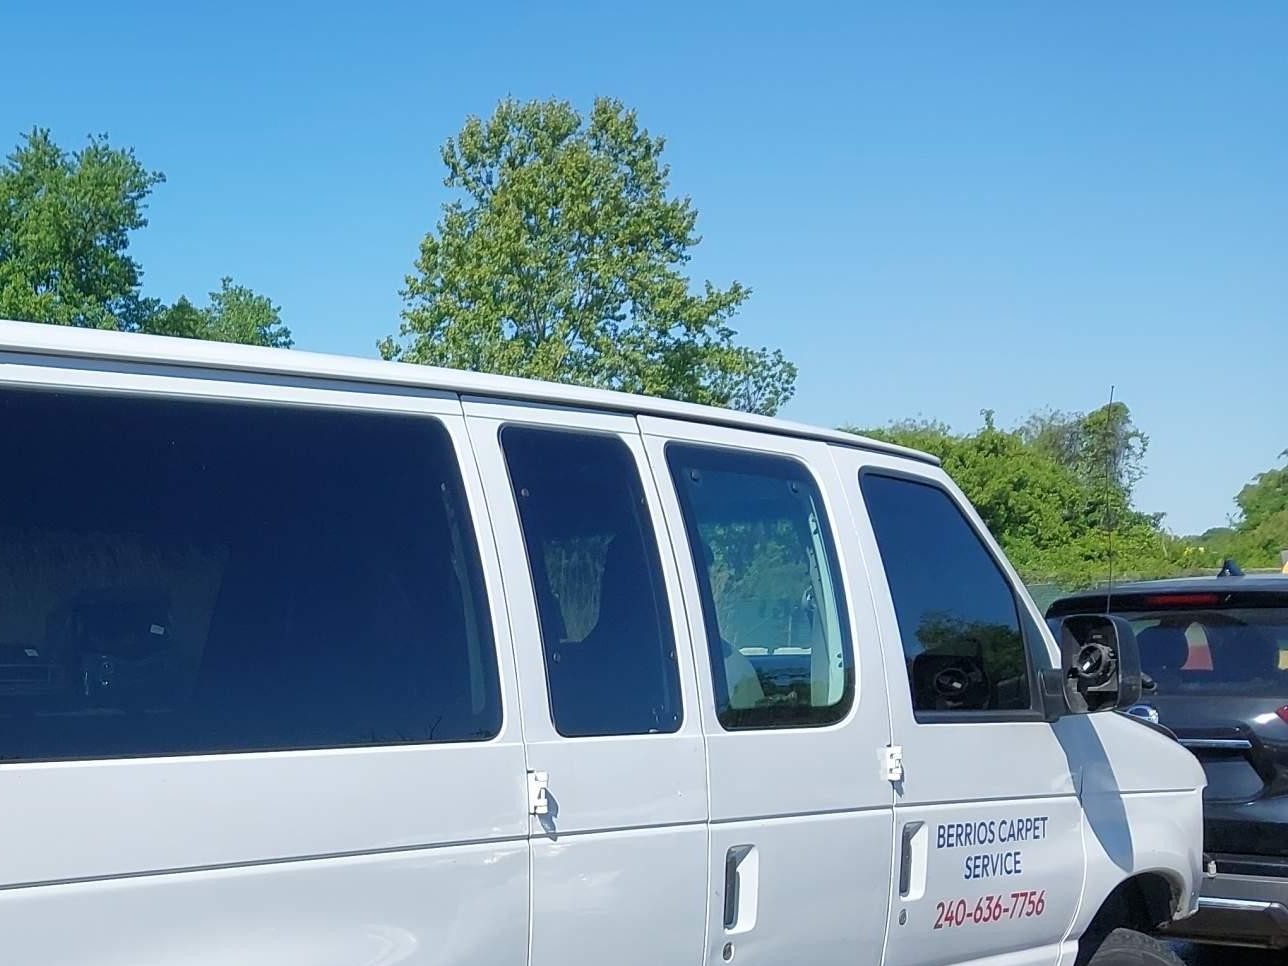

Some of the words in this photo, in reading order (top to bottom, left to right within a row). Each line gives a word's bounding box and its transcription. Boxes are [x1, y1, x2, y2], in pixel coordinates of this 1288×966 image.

[936, 821, 995, 848] BERRIOS
[998, 816, 1048, 842] CARPET
[964, 851, 1022, 879] SERVICE
[933, 890, 1046, 930] 240-636-7756
